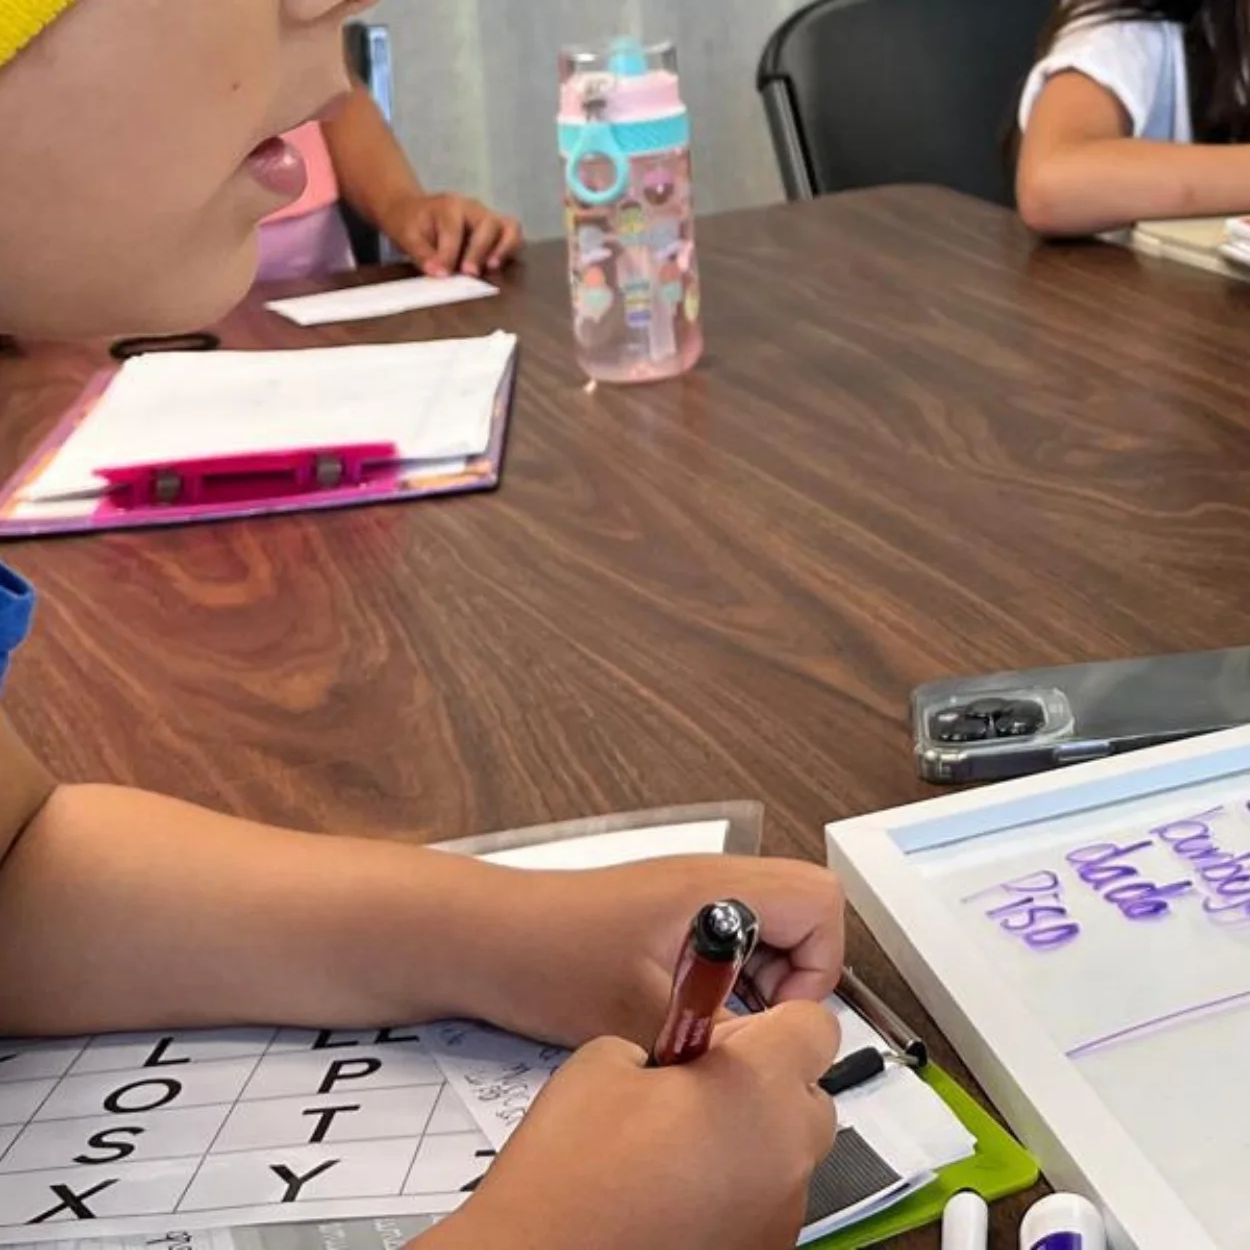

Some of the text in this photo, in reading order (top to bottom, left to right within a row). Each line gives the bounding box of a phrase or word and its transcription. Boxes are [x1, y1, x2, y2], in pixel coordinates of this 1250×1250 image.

[1067, 841, 1193, 920] dado
[142, 1037, 191, 1067] L
[318, 1058, 382, 1094] P
[103, 1078, 184, 1113] O
[302, 1105, 361, 1143] T
[73, 1127, 144, 1165] S
[269, 1160, 339, 1203] Y
[27, 1179, 118, 1224] X
